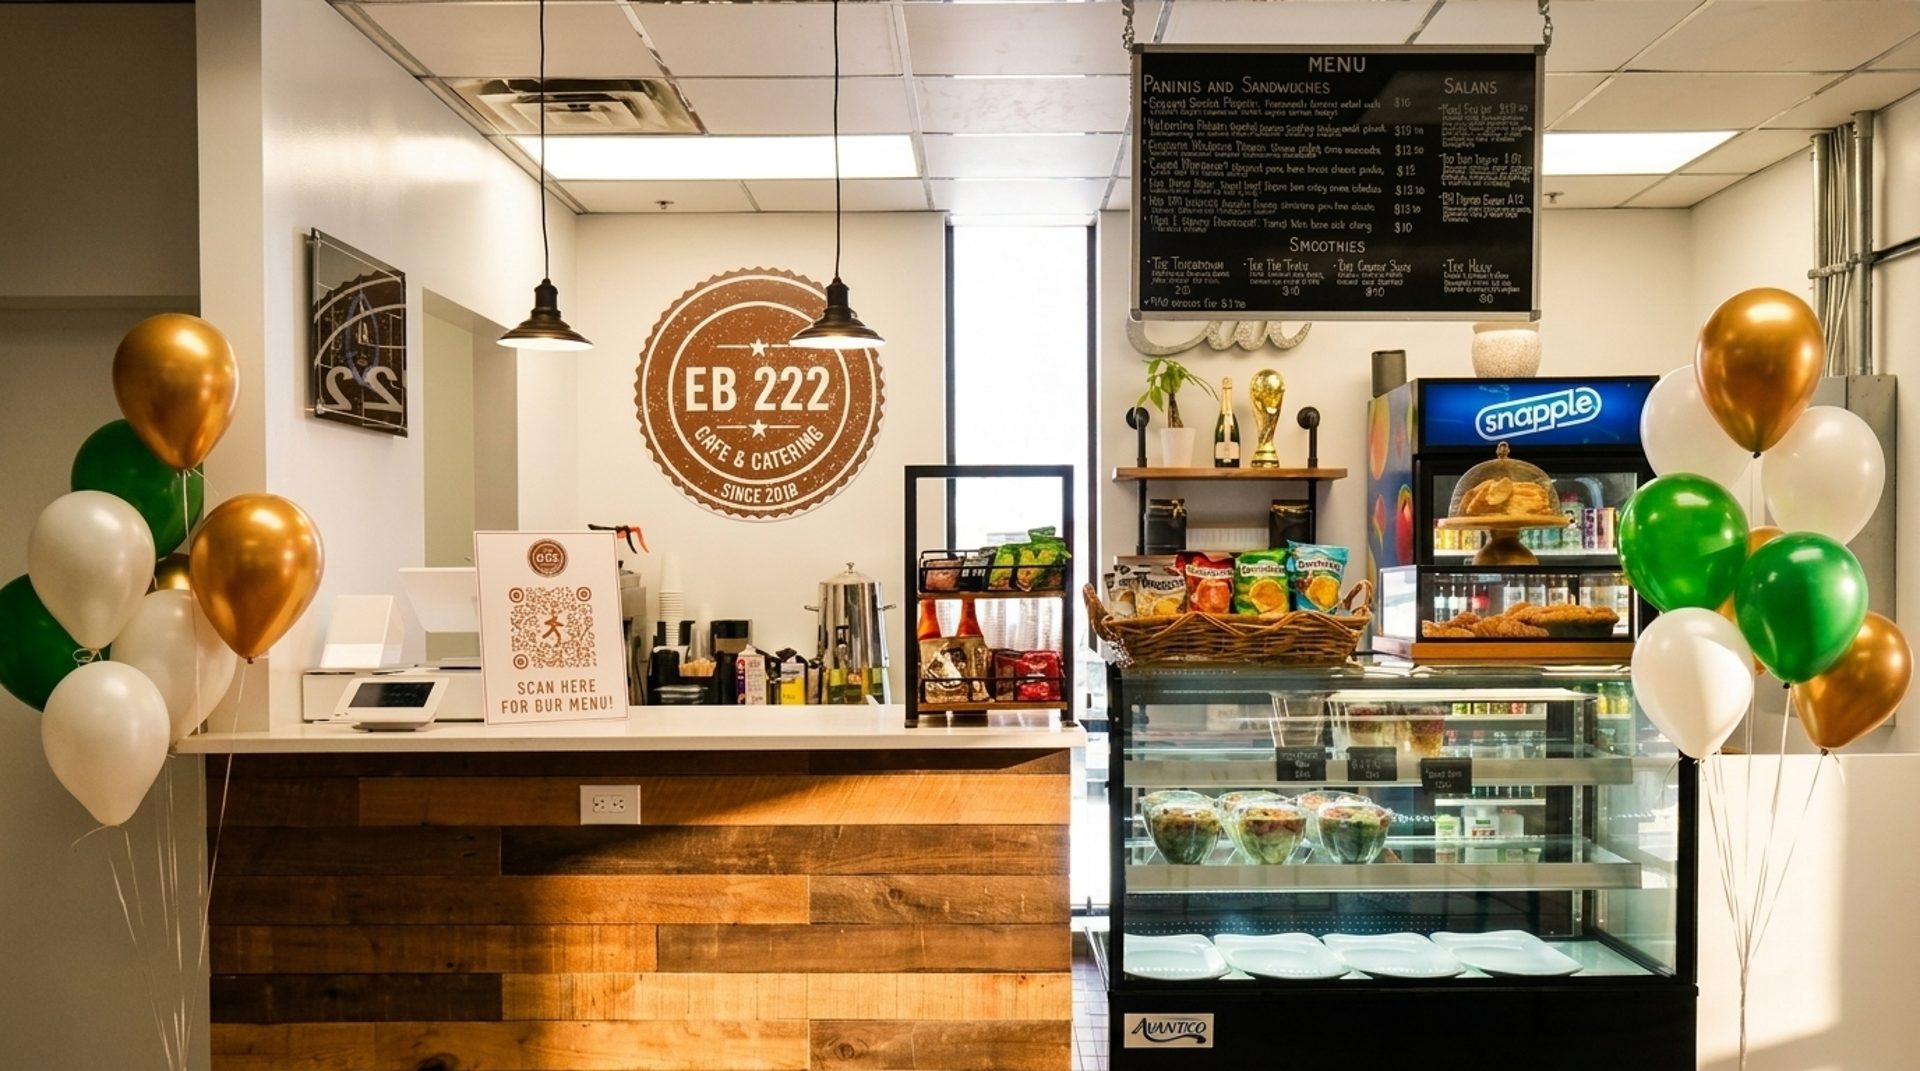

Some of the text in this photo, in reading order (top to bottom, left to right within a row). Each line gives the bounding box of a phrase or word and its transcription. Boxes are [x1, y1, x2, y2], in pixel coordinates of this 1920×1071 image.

[1308, 56, 1366, 72] MENU
[1143, 74, 1201, 93] PANINIS
[1208, 81, 1234, 93] AND
[1443, 77, 1498, 94] SALANS
[1289, 237, 1366, 252] SMOOTHIES
[686, 366, 830, 412] EB 222
[1485, 388, 1596, 432] snapple
[694, 426, 732, 463] CAFE
[752, 425, 824, 471] CATERING
[721, 483, 761, 503] SINCE
[517, 679, 596, 695] SCAN HERE
[501, 699, 528, 714] FOR
[569, 695, 613, 711] MENU!
